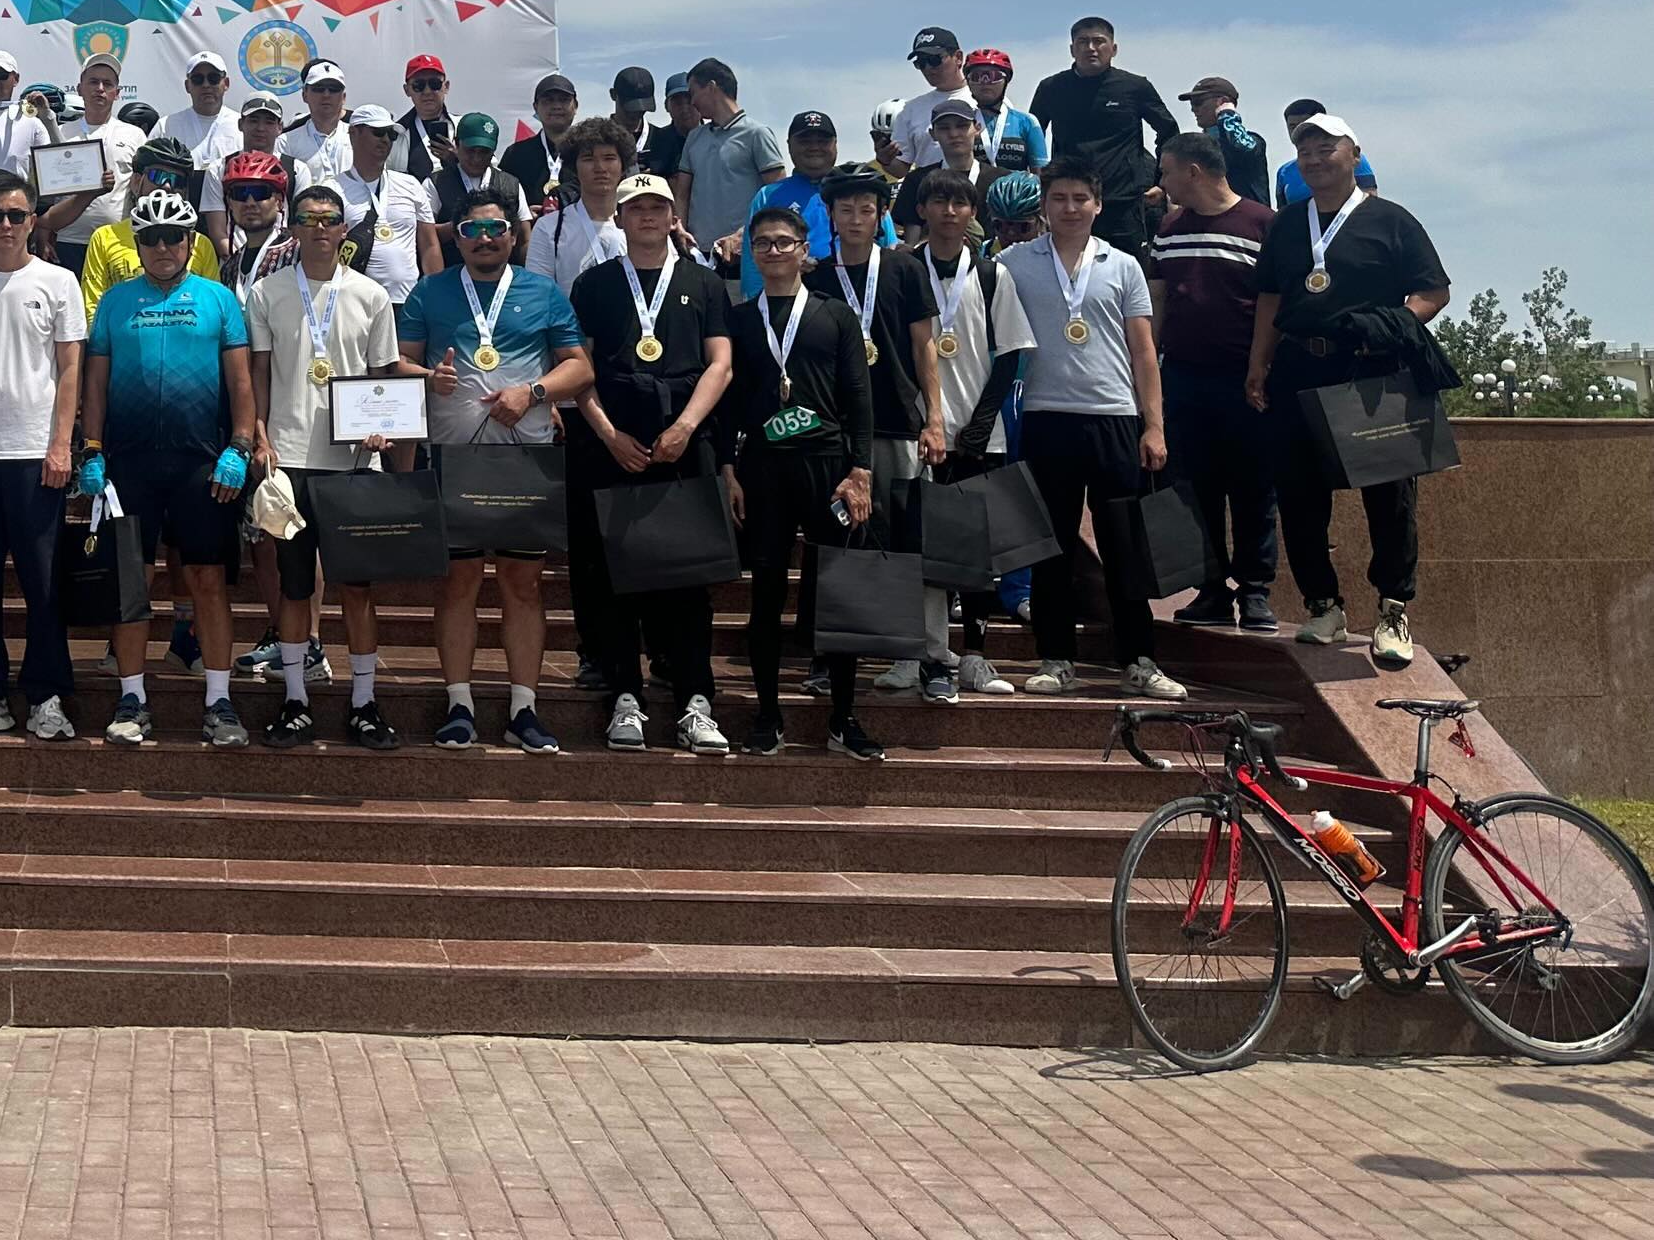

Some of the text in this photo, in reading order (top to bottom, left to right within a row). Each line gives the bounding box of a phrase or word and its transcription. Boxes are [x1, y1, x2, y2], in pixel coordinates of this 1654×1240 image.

[635, 176, 651, 187] NY
[130, 309, 198, 321] ASTANA
[772, 408, 812, 436] 059
[1294, 837, 1361, 902] MOSSO
